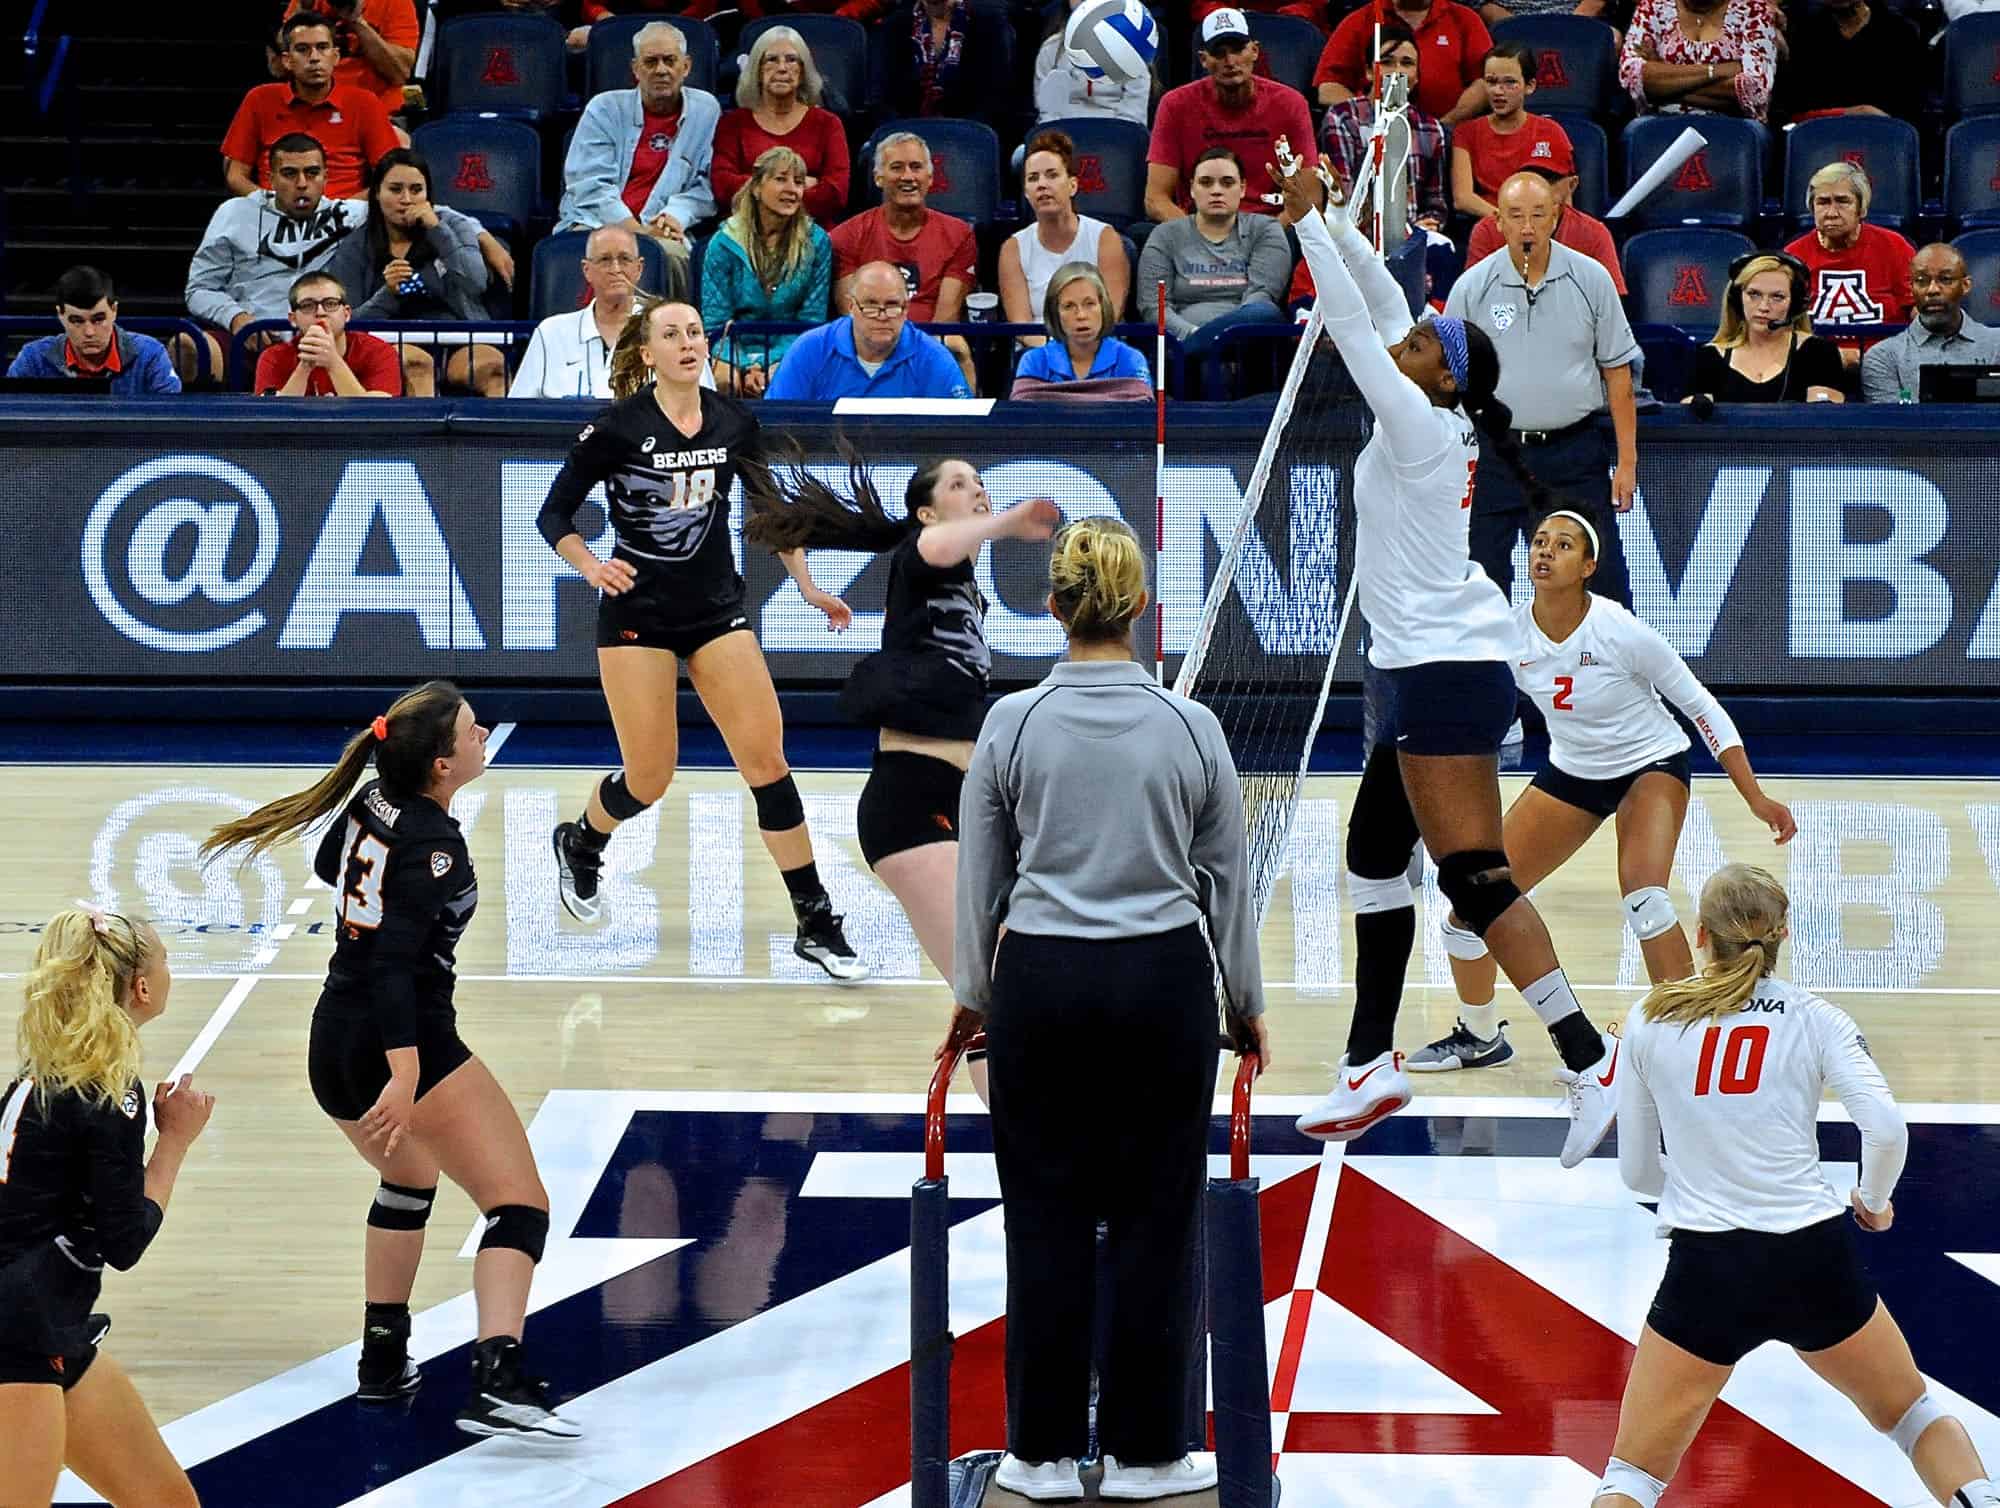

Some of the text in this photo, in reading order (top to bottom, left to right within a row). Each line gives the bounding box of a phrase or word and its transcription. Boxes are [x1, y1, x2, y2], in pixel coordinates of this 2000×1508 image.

[1808, 269, 1883, 325] A
[652, 447, 728, 469] BEAVERS
[669, 468, 717, 510] 18
[1552, 676, 1575, 711] 2
[336, 813, 392, 930] 13
[1694, 1024, 1771, 1097] 10
